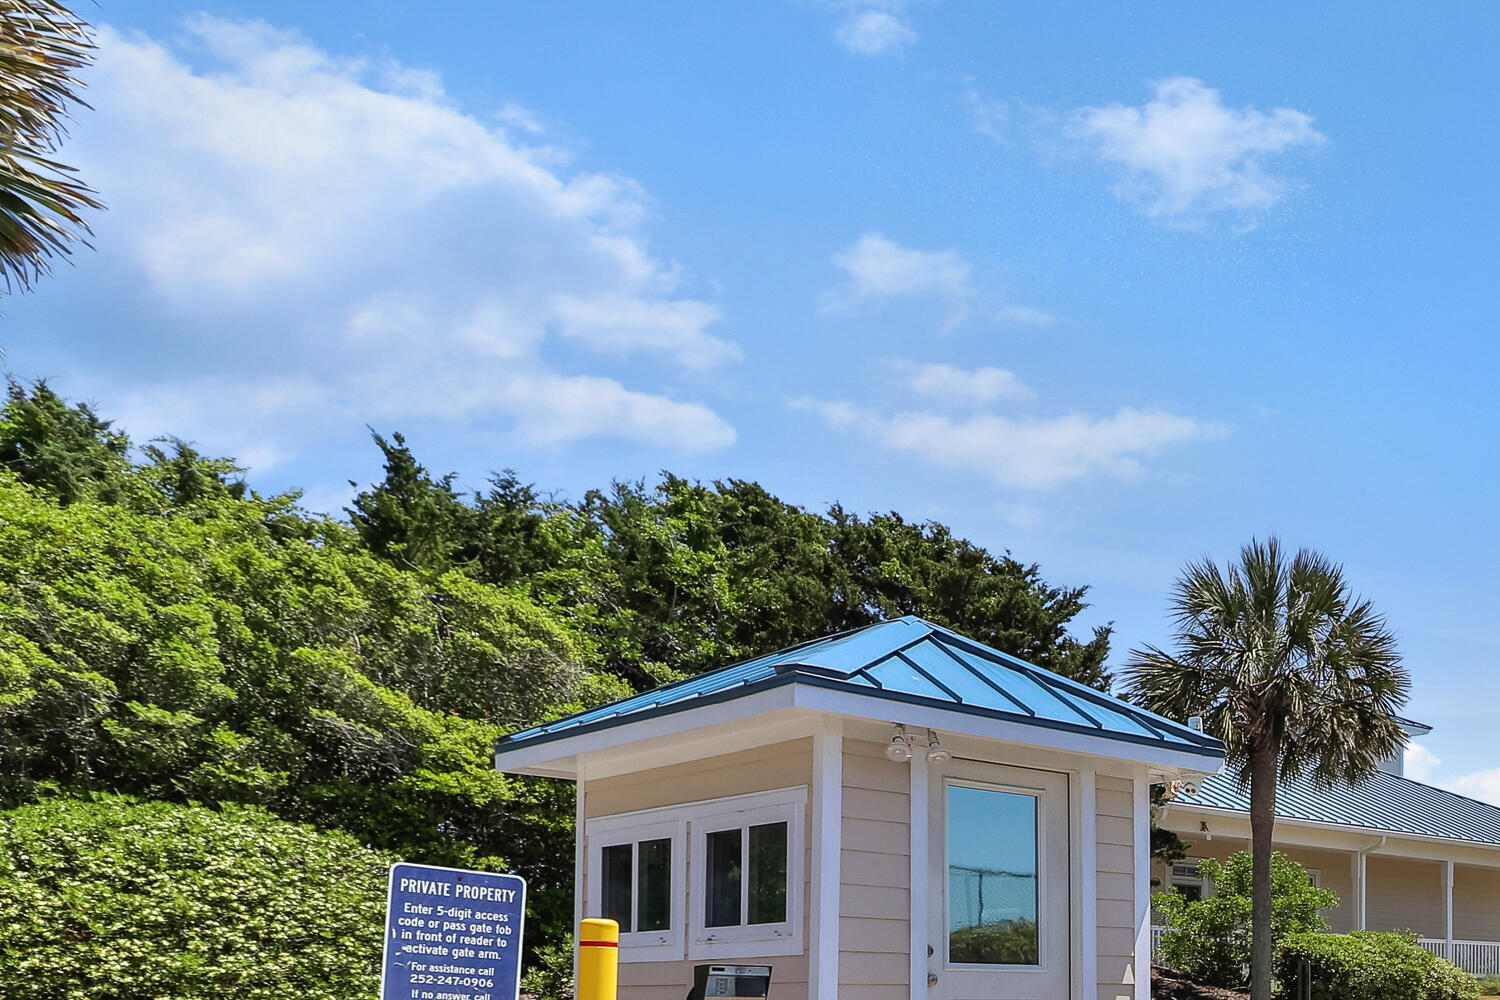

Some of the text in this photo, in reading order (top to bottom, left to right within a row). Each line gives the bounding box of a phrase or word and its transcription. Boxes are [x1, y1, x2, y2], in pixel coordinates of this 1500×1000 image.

[400, 879, 516, 903] PRIVATE PROPERTY
[404, 903, 509, 922] Enter 5-digit access
[398, 917, 511, 935] code or pass gate fob
[401, 929, 507, 947] in front of reader to
[407, 944, 501, 960] activate gate arm.
[411, 962, 494, 976] For assistance call
[410, 974, 493, 988] 252-247-0906
[412, 989, 419, 998] If
[421, 991, 433, 1000] no
